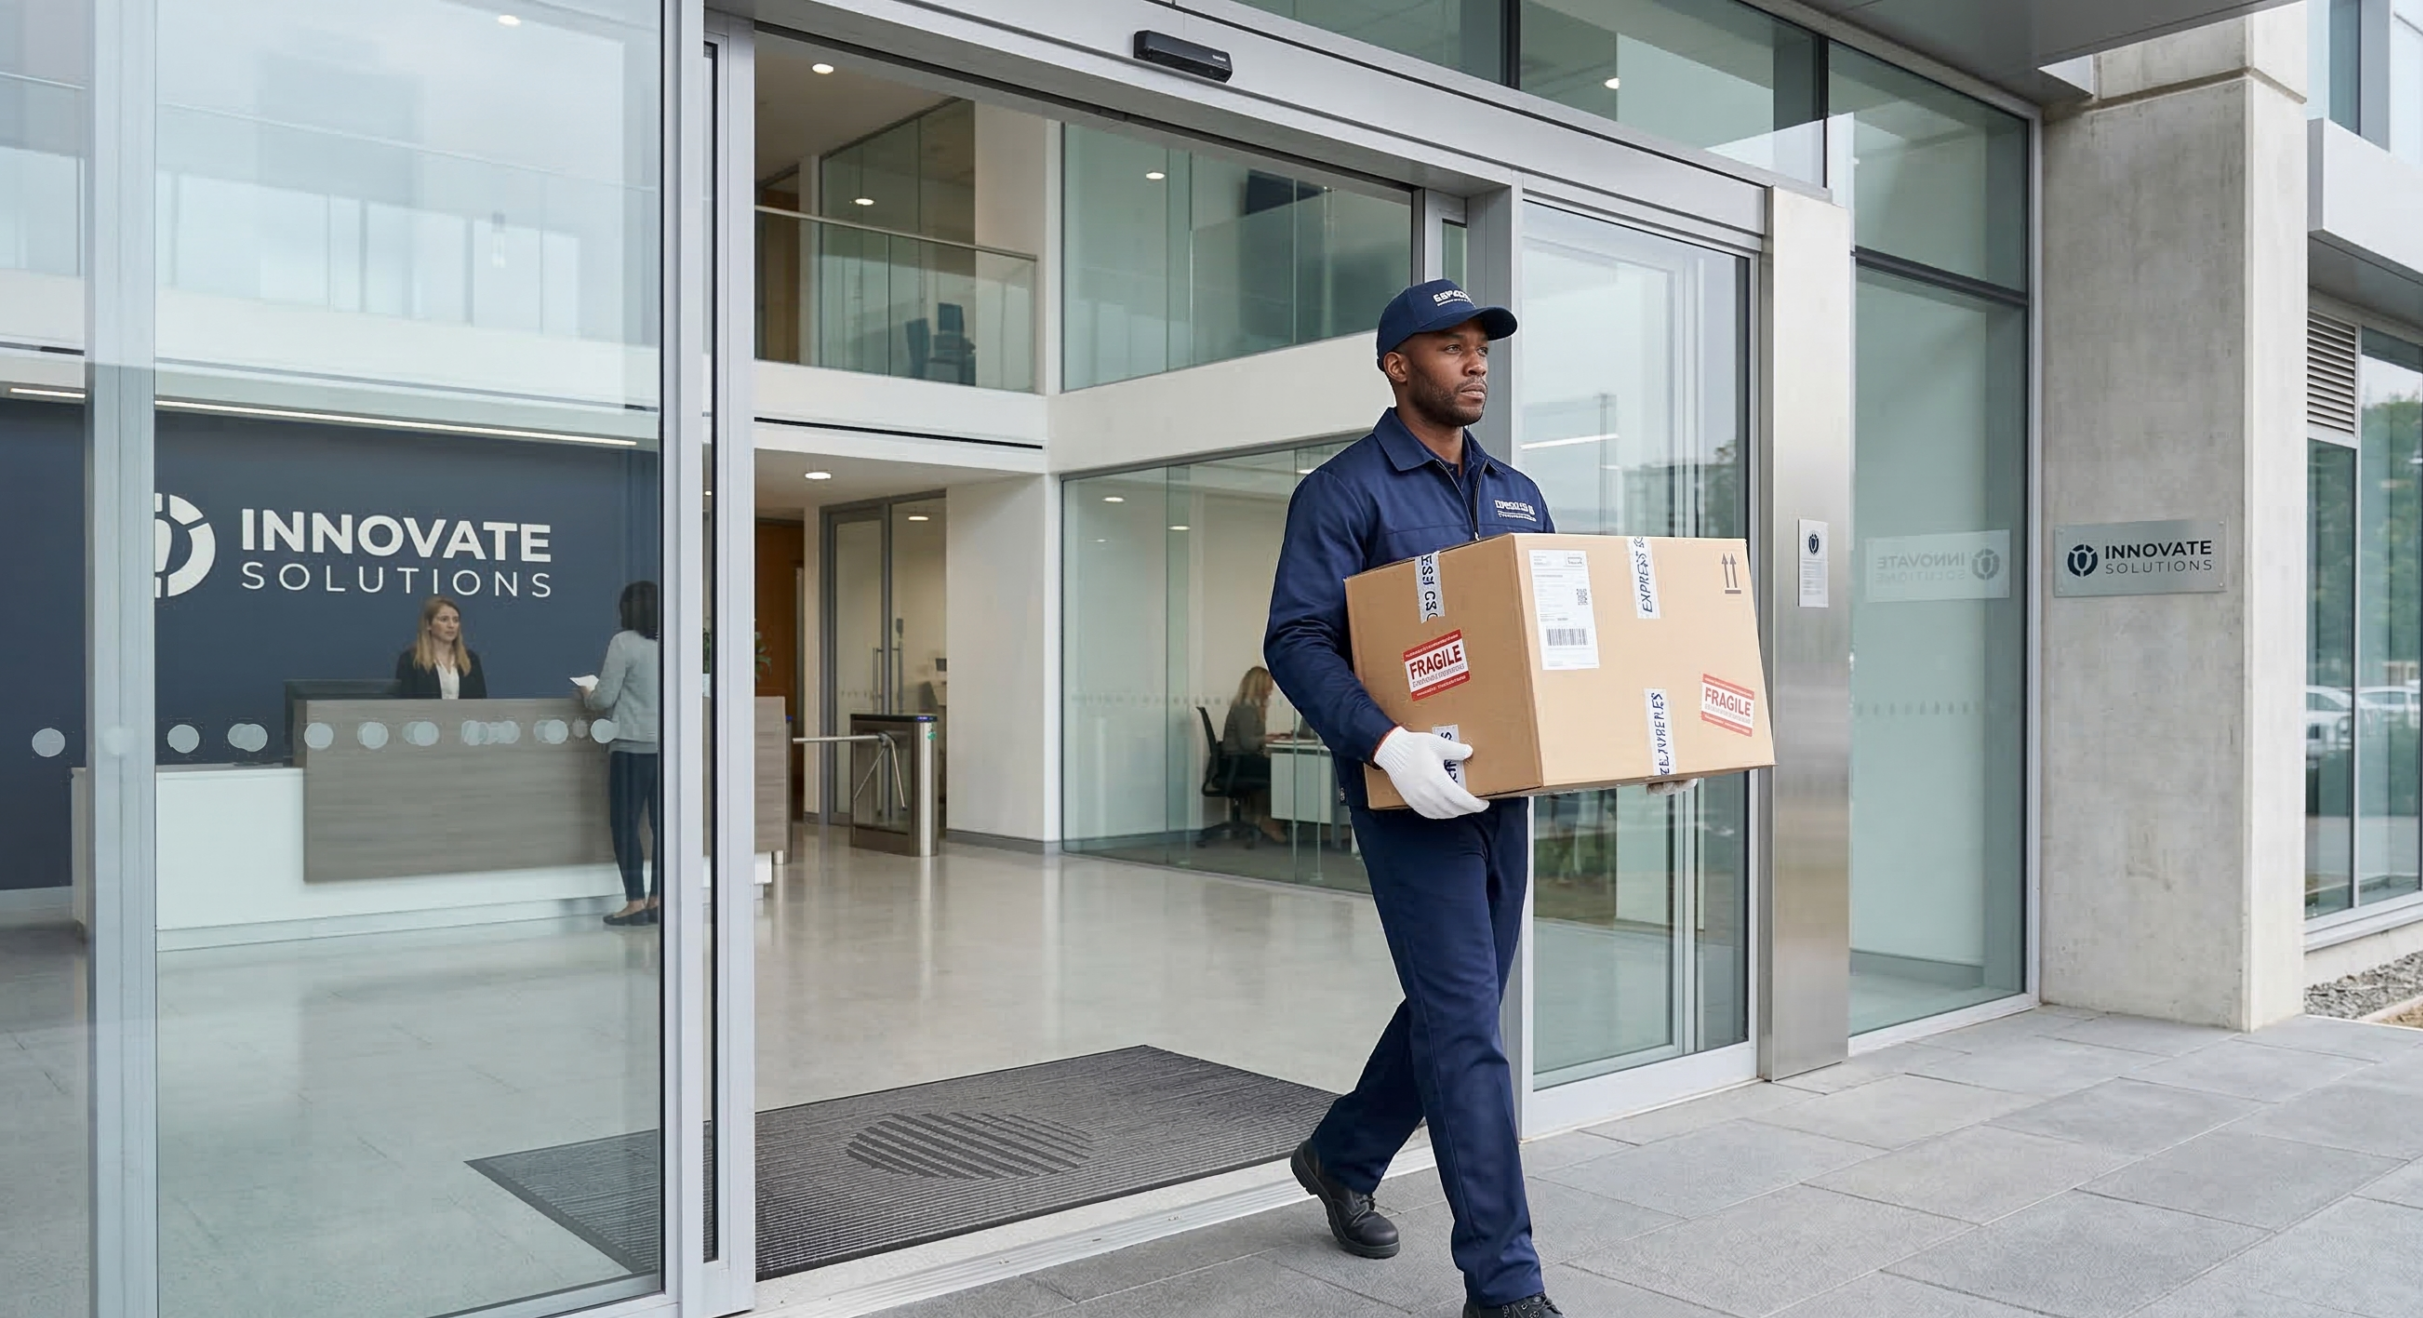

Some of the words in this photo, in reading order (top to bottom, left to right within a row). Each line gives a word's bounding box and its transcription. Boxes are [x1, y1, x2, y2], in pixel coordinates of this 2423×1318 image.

[242, 508, 551, 562] INNOVATE
[2105, 540, 2212, 559] INNOVATE
[242, 561, 551, 597] SOLUTIONS
[2105, 559, 2212, 575] SOLUTIONS
[1409, 644, 1462, 680] FRAGILE
[1705, 687, 1751, 717] FRAGILE
